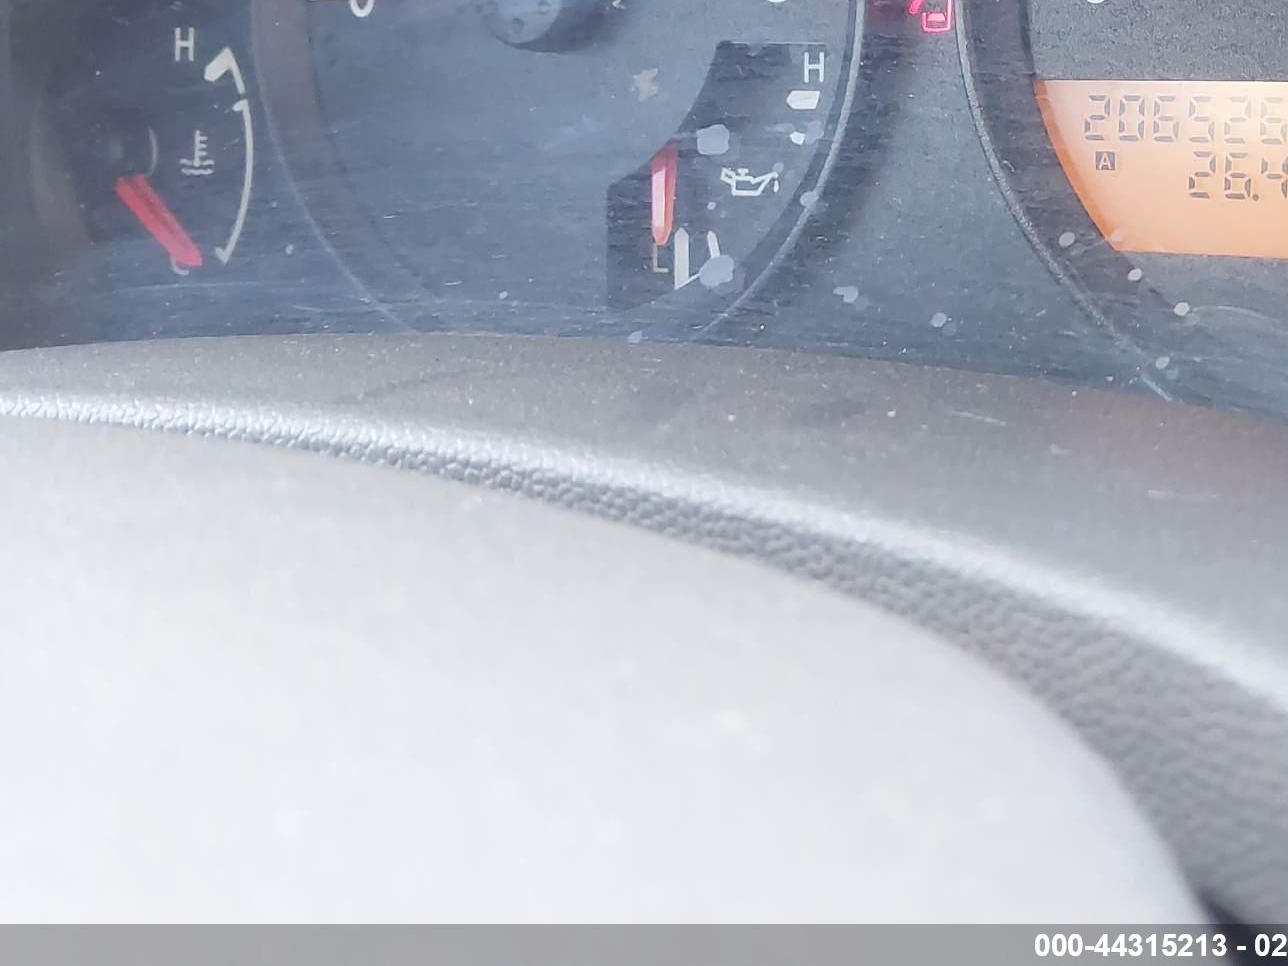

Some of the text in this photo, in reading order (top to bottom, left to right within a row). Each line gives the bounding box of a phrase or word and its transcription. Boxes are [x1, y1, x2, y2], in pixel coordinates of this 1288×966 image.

[174, 28, 194, 62] H
[803, 53, 824, 83] H
[1084, 94, 1288, 145] 206526
[1098, 152, 1113, 171] A
